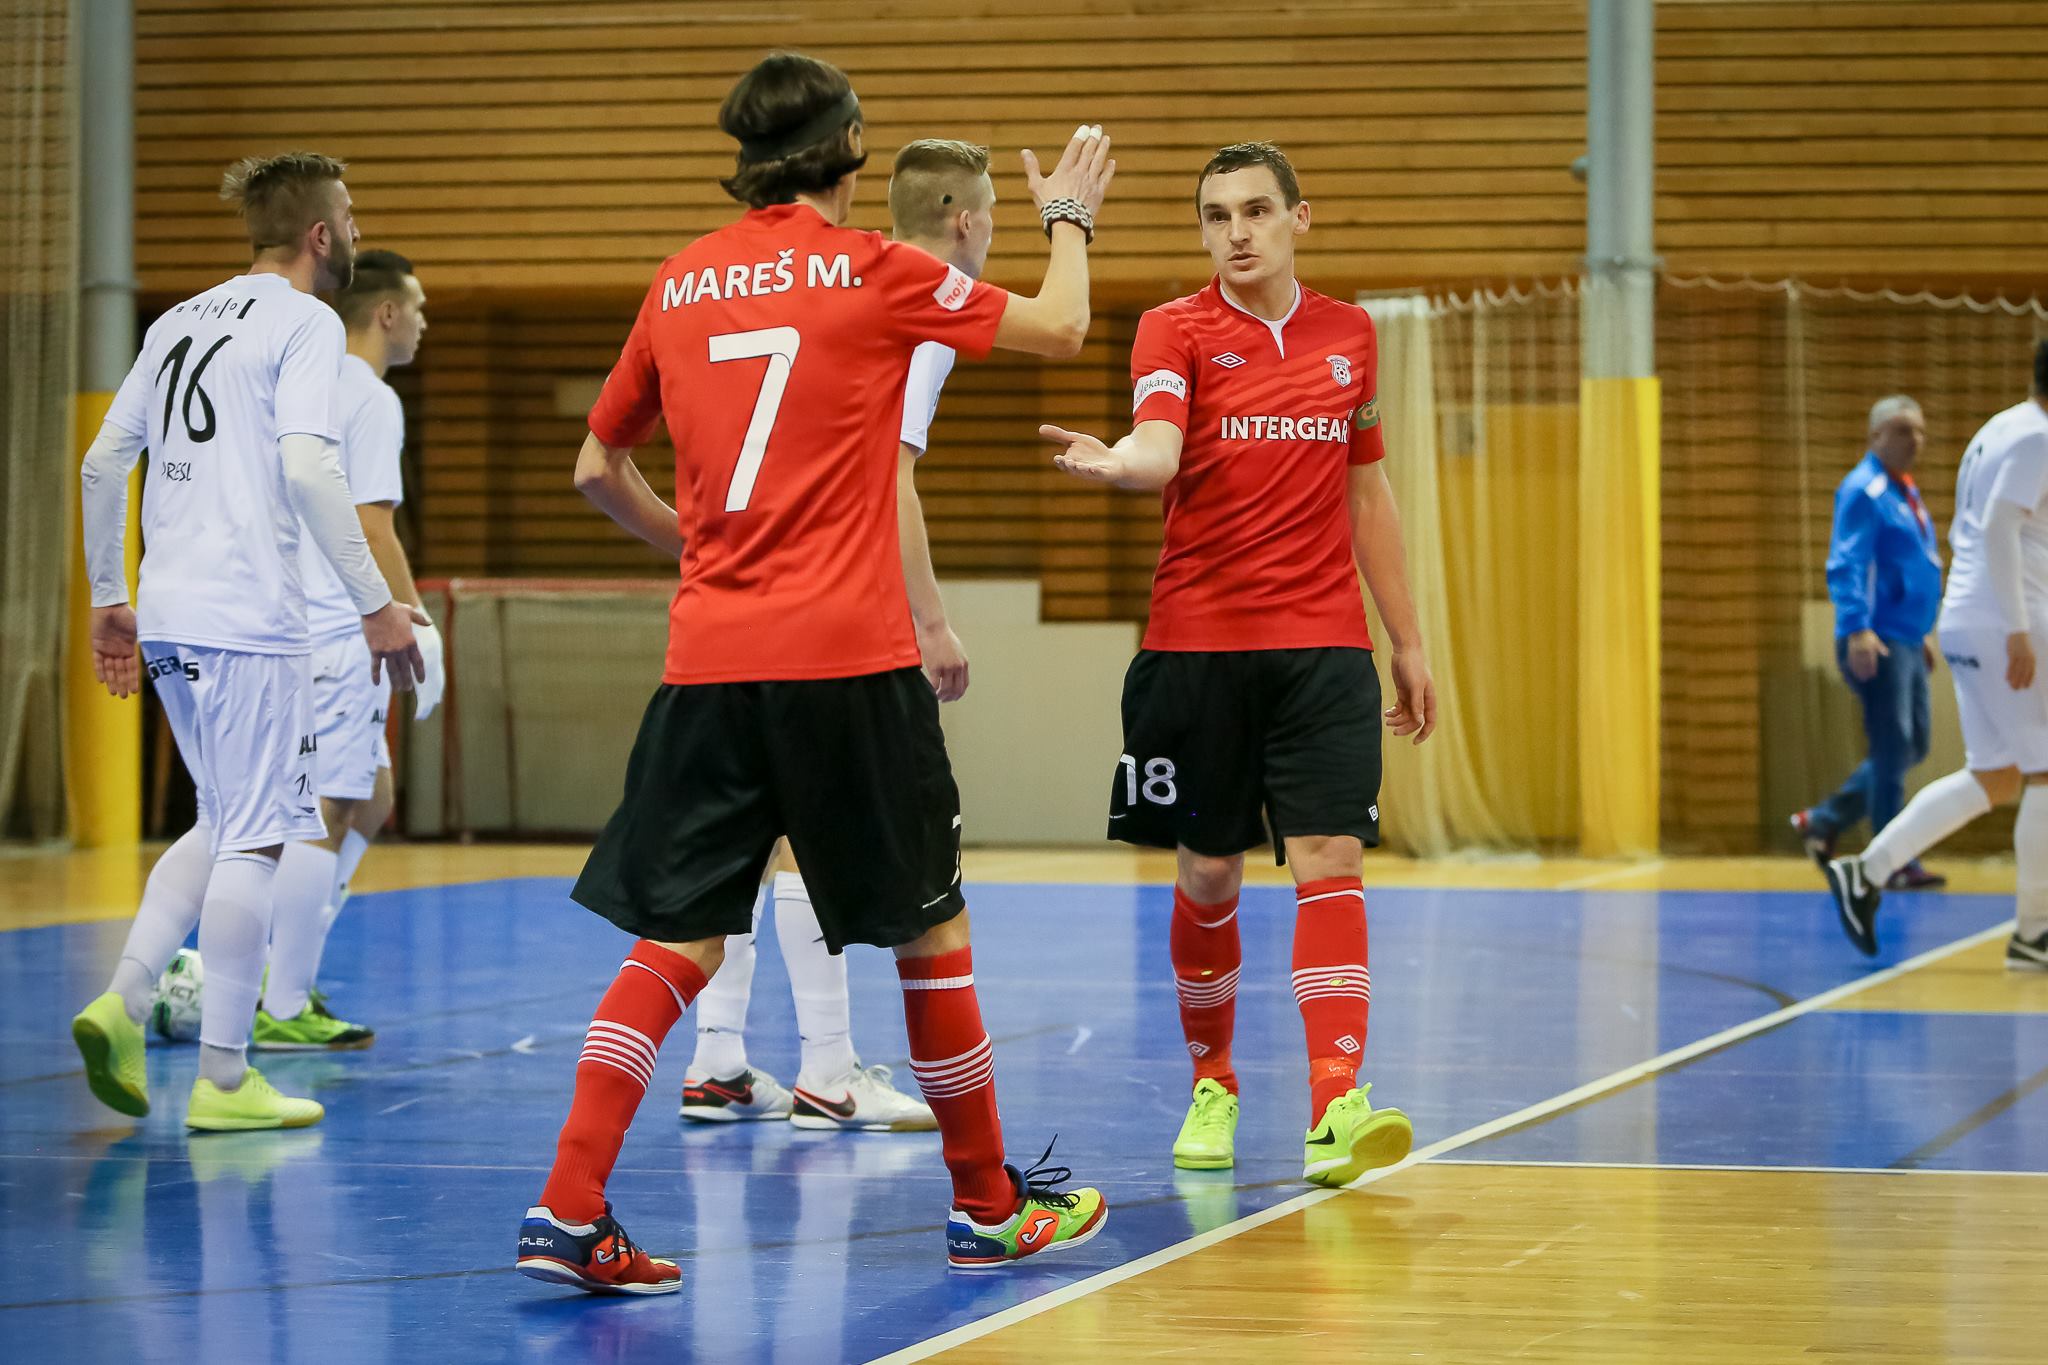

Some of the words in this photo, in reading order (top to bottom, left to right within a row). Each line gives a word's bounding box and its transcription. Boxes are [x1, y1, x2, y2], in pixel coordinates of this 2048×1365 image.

[661, 248, 795, 312] MAREŠ
[806, 253, 863, 288] M.
[943, 275, 967, 305] moje
[155, 334, 233, 445] 16
[708, 326, 801, 512] 7
[1119, 753, 1177, 806] 18
